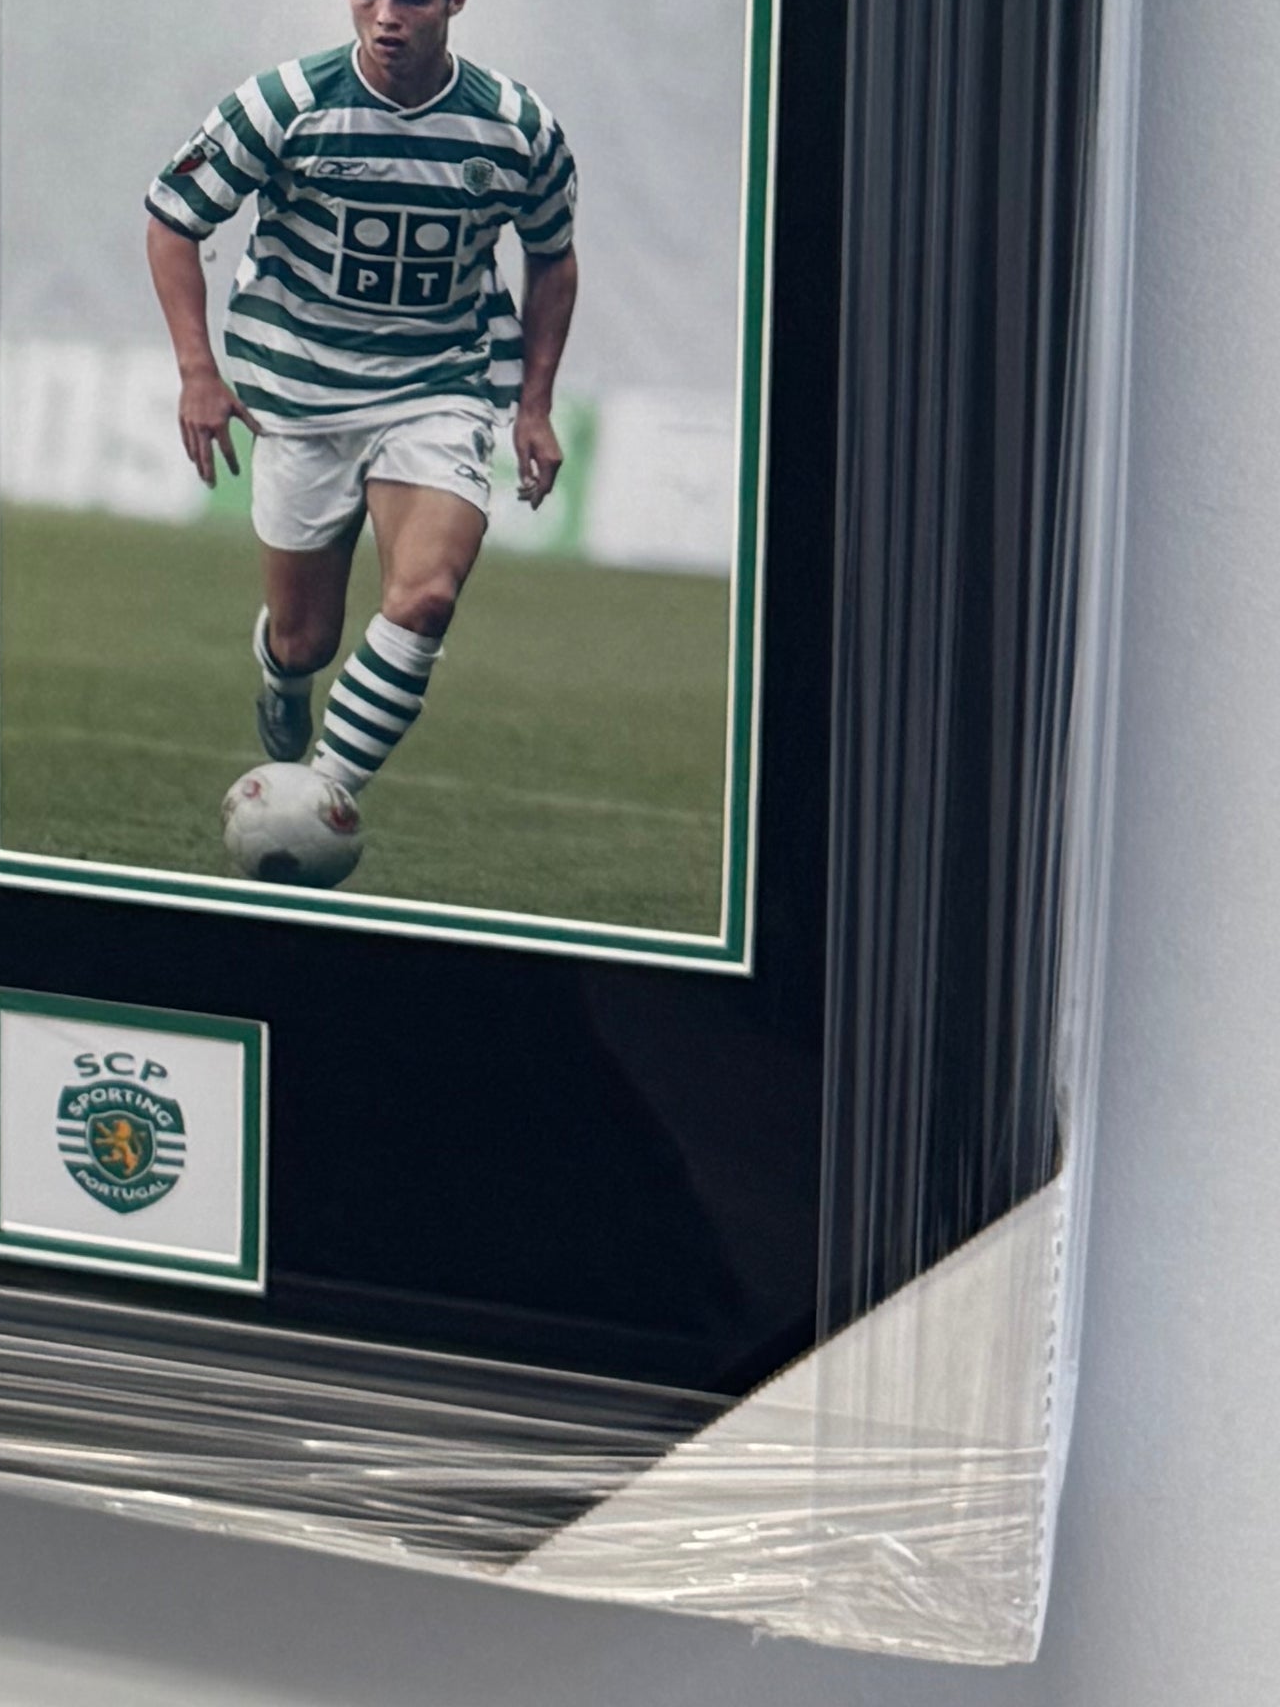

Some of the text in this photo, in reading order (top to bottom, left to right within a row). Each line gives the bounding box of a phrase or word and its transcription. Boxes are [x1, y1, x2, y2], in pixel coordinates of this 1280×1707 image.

[74, 1051, 168, 1081] SCP
[67, 1087, 174, 1127] SPORTING
[76, 1170, 169, 1200] PORTUGAL
